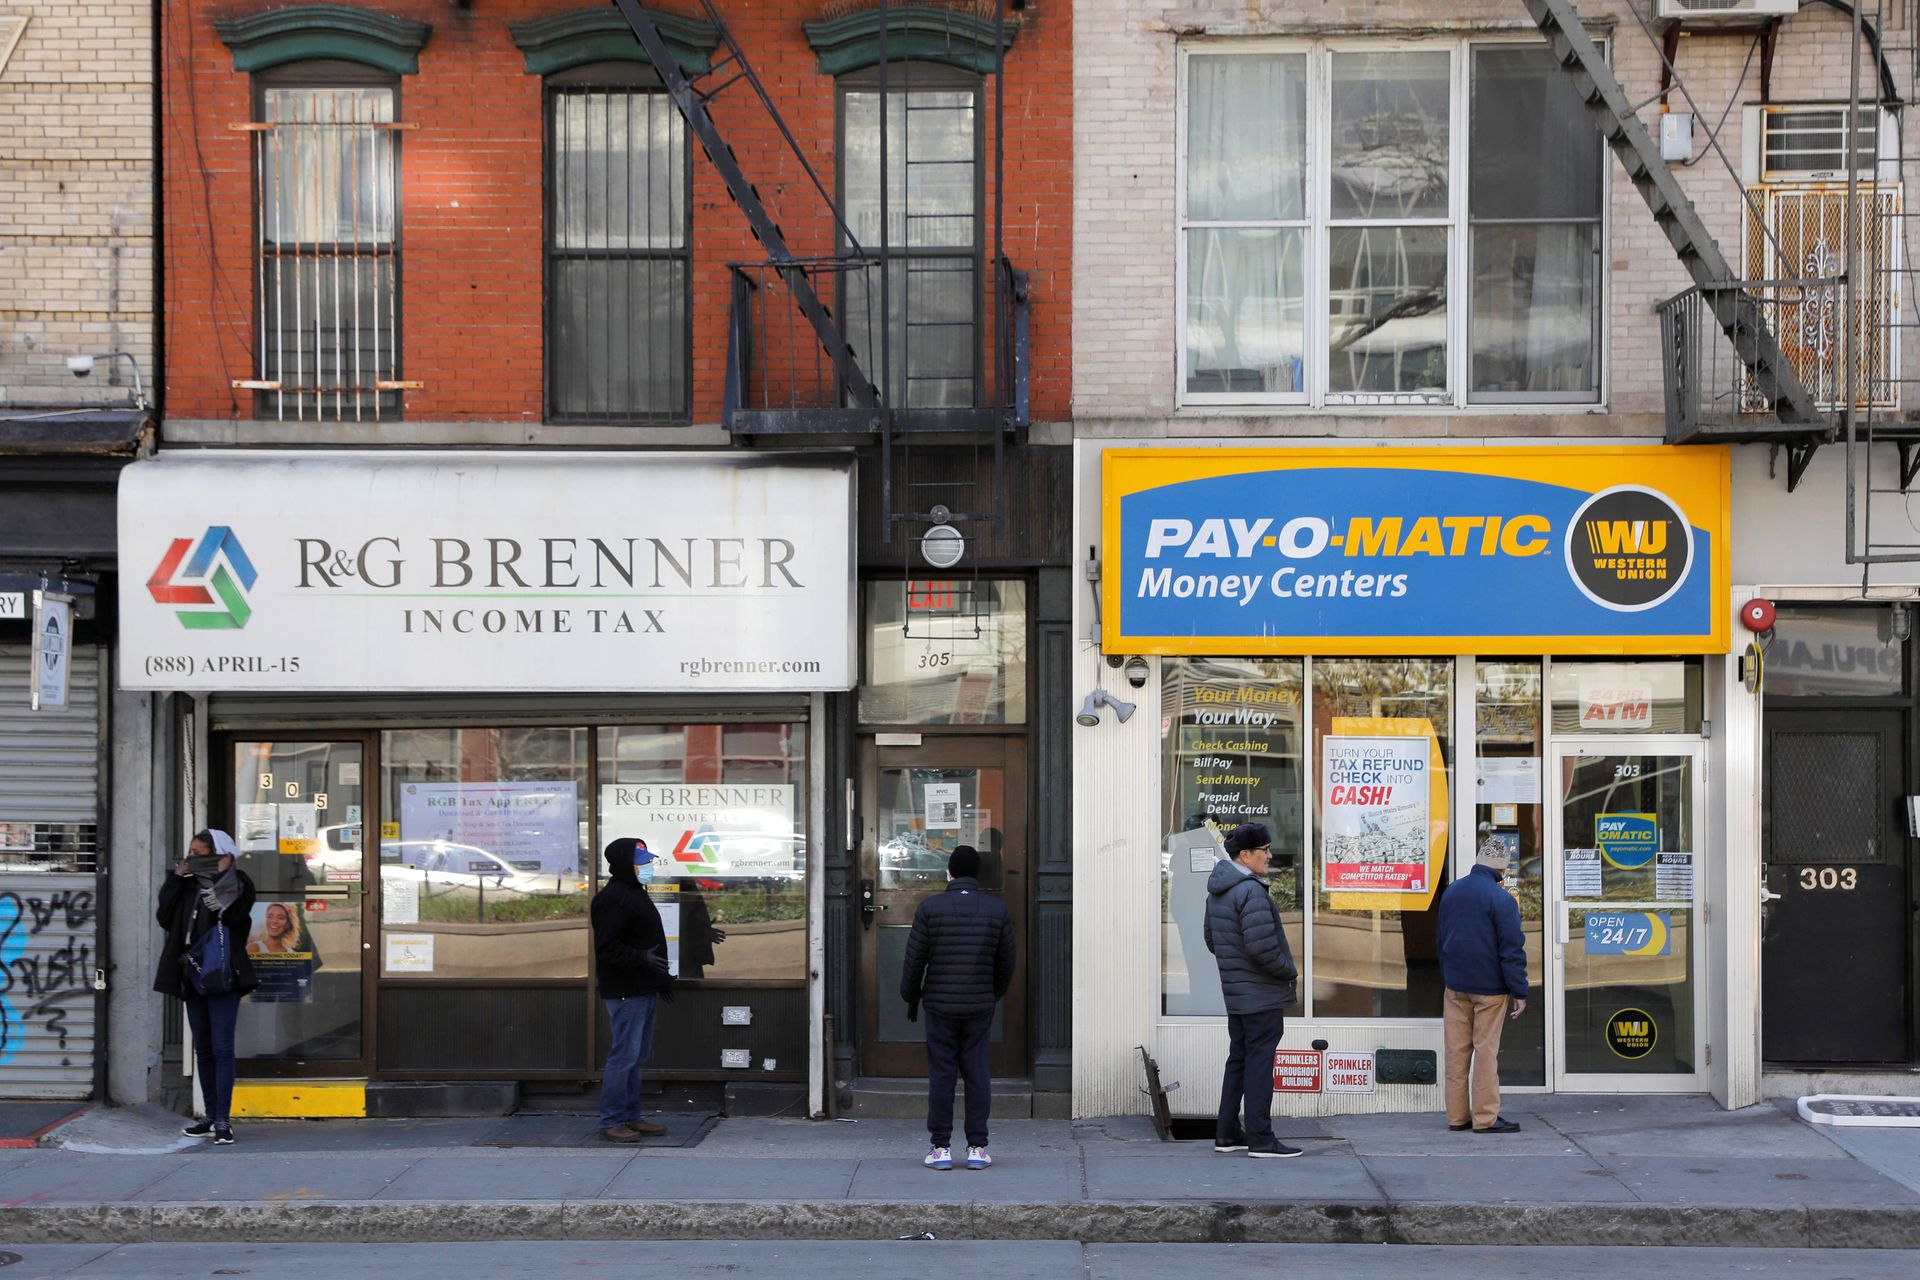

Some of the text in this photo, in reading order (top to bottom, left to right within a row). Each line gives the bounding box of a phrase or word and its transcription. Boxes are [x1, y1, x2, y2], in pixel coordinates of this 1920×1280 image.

[1144, 514, 1551, 559] PAY-O-MATIC
[1586, 520, 1667, 555] WU
[294, 537, 806, 588] R&G BRENNER
[1593, 558, 1667, 569] WESTERN
[1616, 569, 1667, 580] UNION
[1137, 566, 1409, 607] Money Centers
[404, 608, 667, 634] INCOME TAX
[145, 655, 300, 677] (888) APRIL-15
[679, 656, 821, 678] rgbrenner.com
[917, 652, 950, 669] 305
[1195, 687, 1302, 706] Your Money,
[1587, 690, 1644, 700] 24 HR
[1583, 702, 1649, 721] ATM
[1193, 708, 1278, 730] Your Way.
[1191, 740, 1269, 753] Check Cashing
[1330, 748, 1394, 758] TURN YOUR
[1193, 757, 1233, 770] Bill Pay
[1329, 758, 1424, 771] TAX REFUND
[1613, 765, 1641, 777] 303
[1195, 774, 1261, 787] Send Money
[1330, 772, 1413, 784] CHECK INTO
[615, 787, 785, 806] R&G BRENNER
[1198, 791, 1240, 804] Prepaid
[1330, 785, 1393, 806] CASH!
[427, 797, 456, 807] RGB
[461, 797, 482, 807] Tax
[489, 797, 511, 808] App
[1206, 804, 1269, 815] Debit Cards
[650, 813, 707, 822] INCOME
[1208, 821, 1240, 831] Mone
[1600, 822, 1626, 831] PAY
[1599, 831, 1652, 840] OMATIC
[1340, 873, 1385, 881] COMPETITOR
[1800, 867, 1858, 890] 303
[1588, 916, 1625, 928] OPEN
[1600, 928, 1648, 945] 24/7
[1276, 1054, 1318, 1064] SPRINKLERS
[1328, 1058, 1372, 1071] SPRINKLER
[1275, 1067, 1319, 1077] THROUGHOUT
[1282, 1077, 1313, 1087] BUILDING
[1332, 1074, 1368, 1086] SIAMESE
